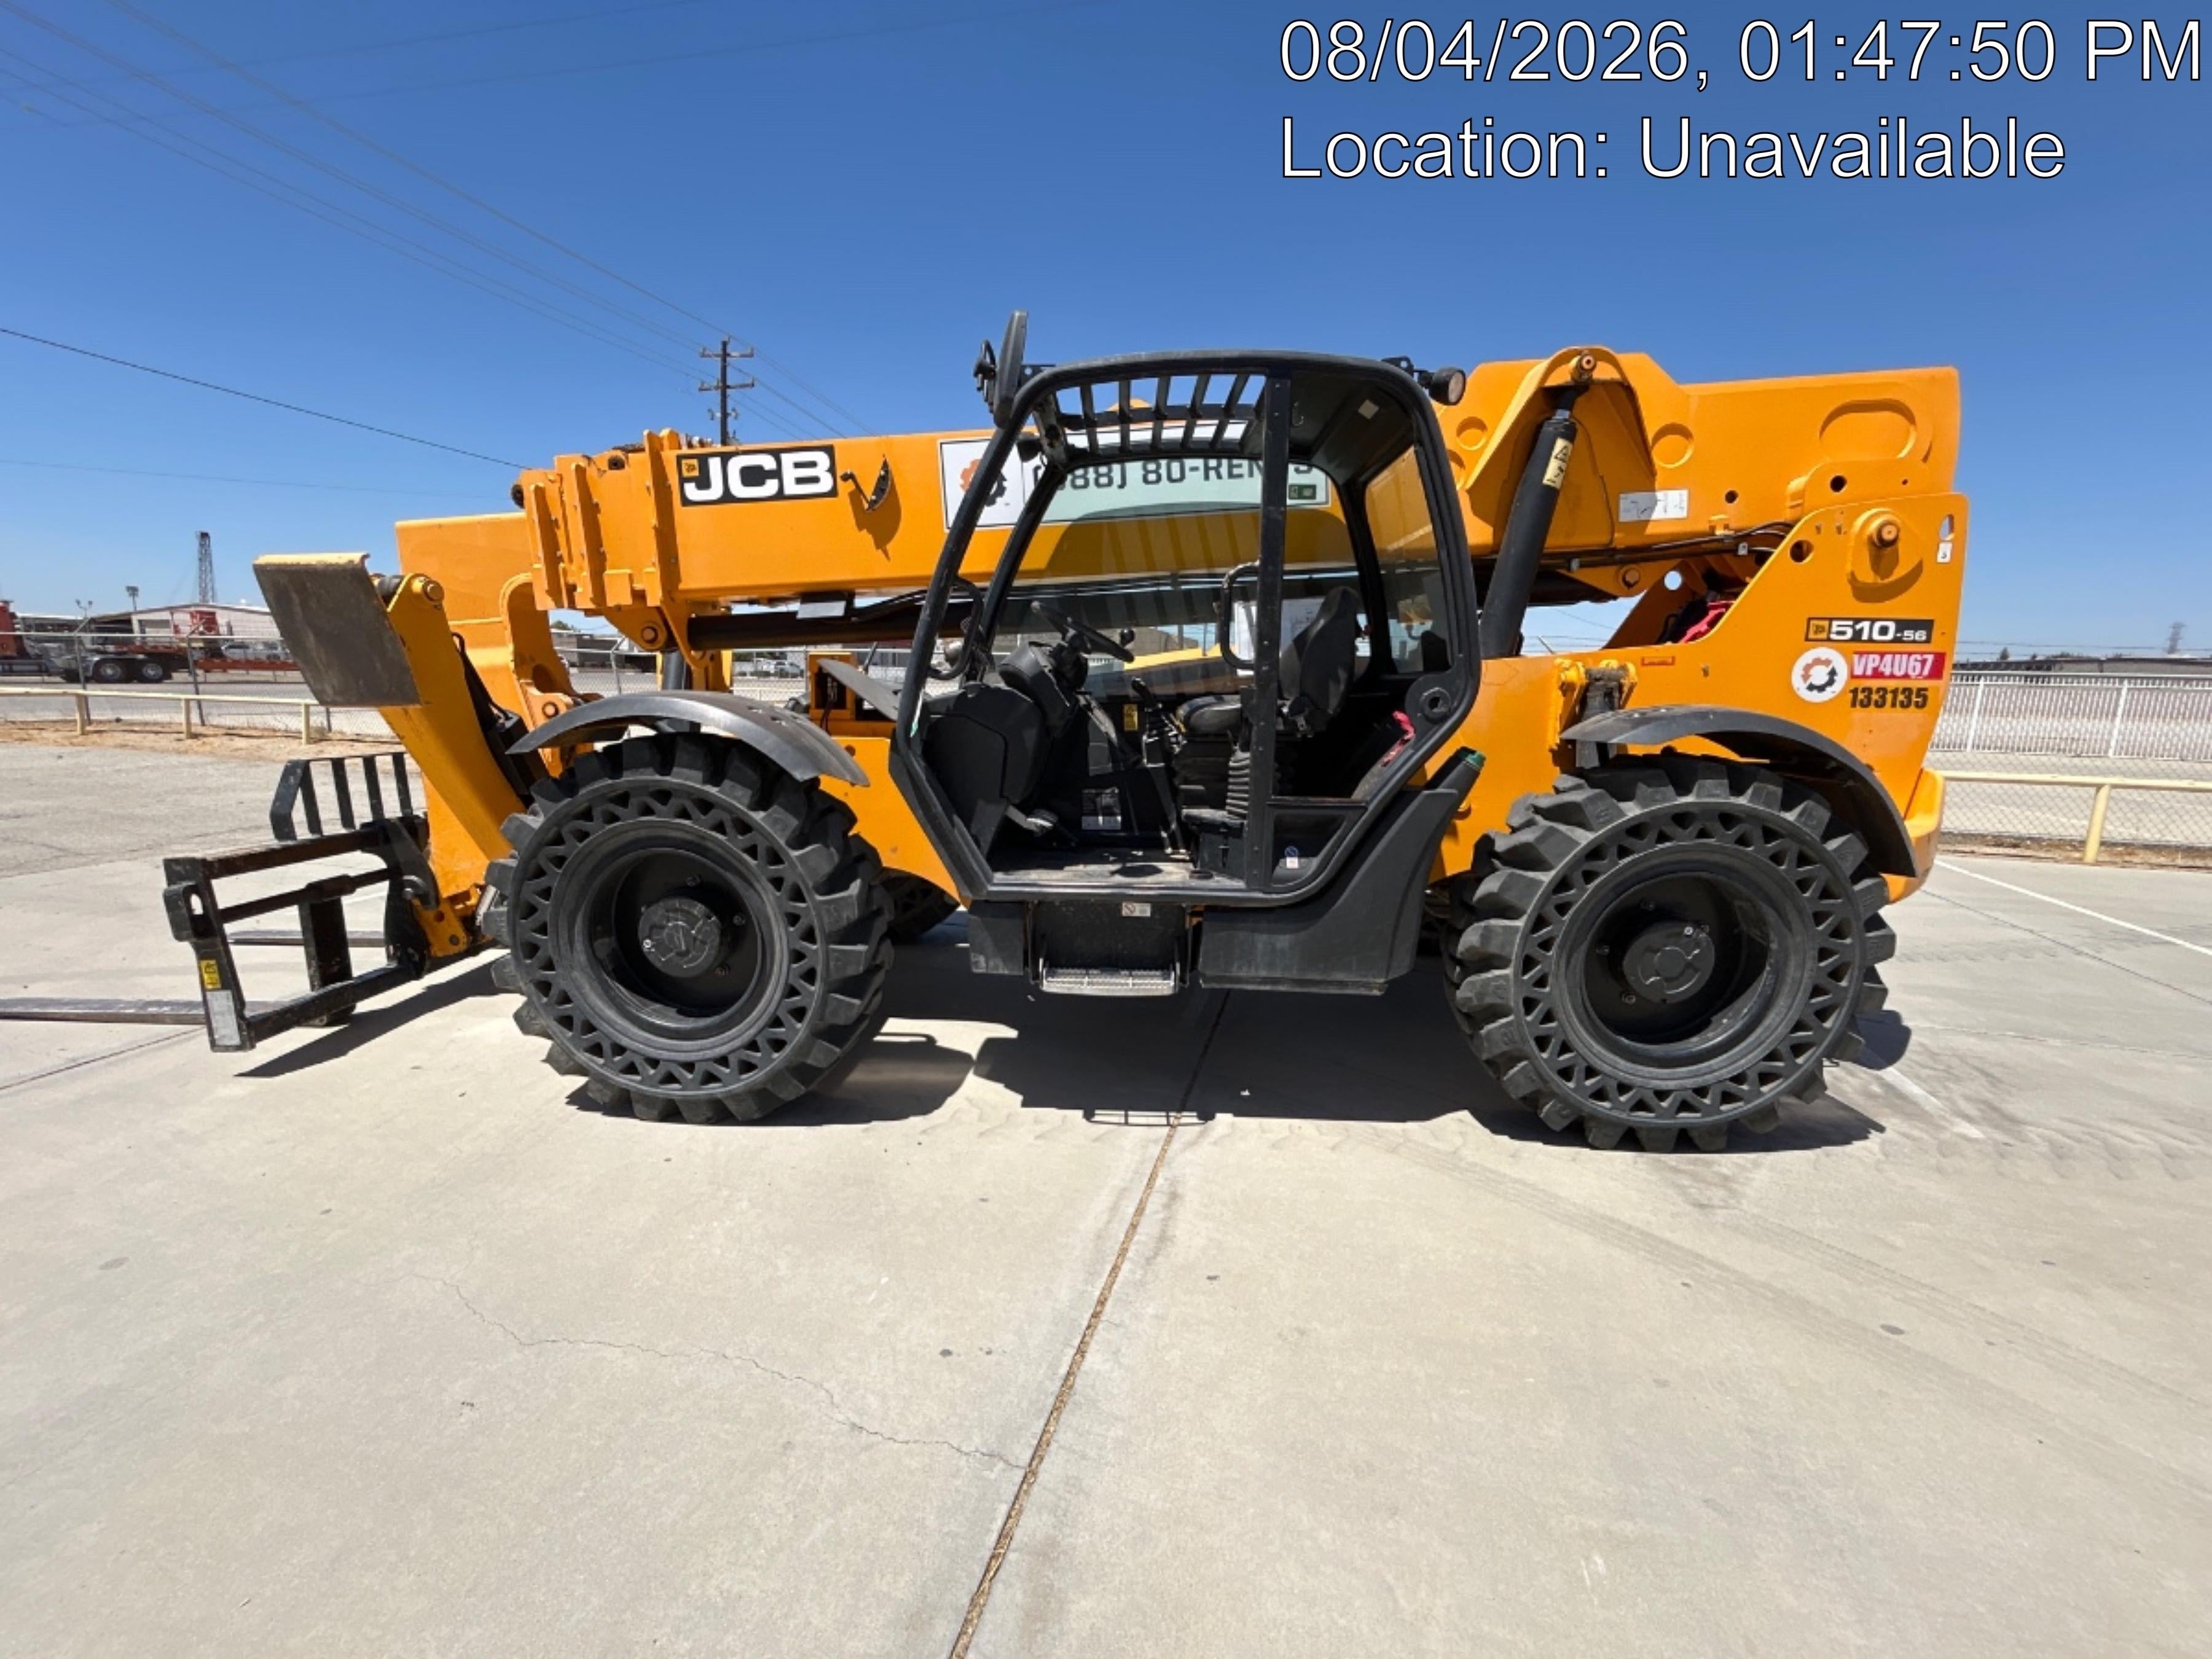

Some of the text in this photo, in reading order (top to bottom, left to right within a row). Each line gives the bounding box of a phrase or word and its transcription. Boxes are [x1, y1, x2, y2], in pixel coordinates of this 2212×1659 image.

[683, 451, 833, 501] JCB
[1830, 621, 1928, 641] 510-56
[1852, 654, 1934, 677] VP4U67
[1848, 686, 1929, 708] 133135
